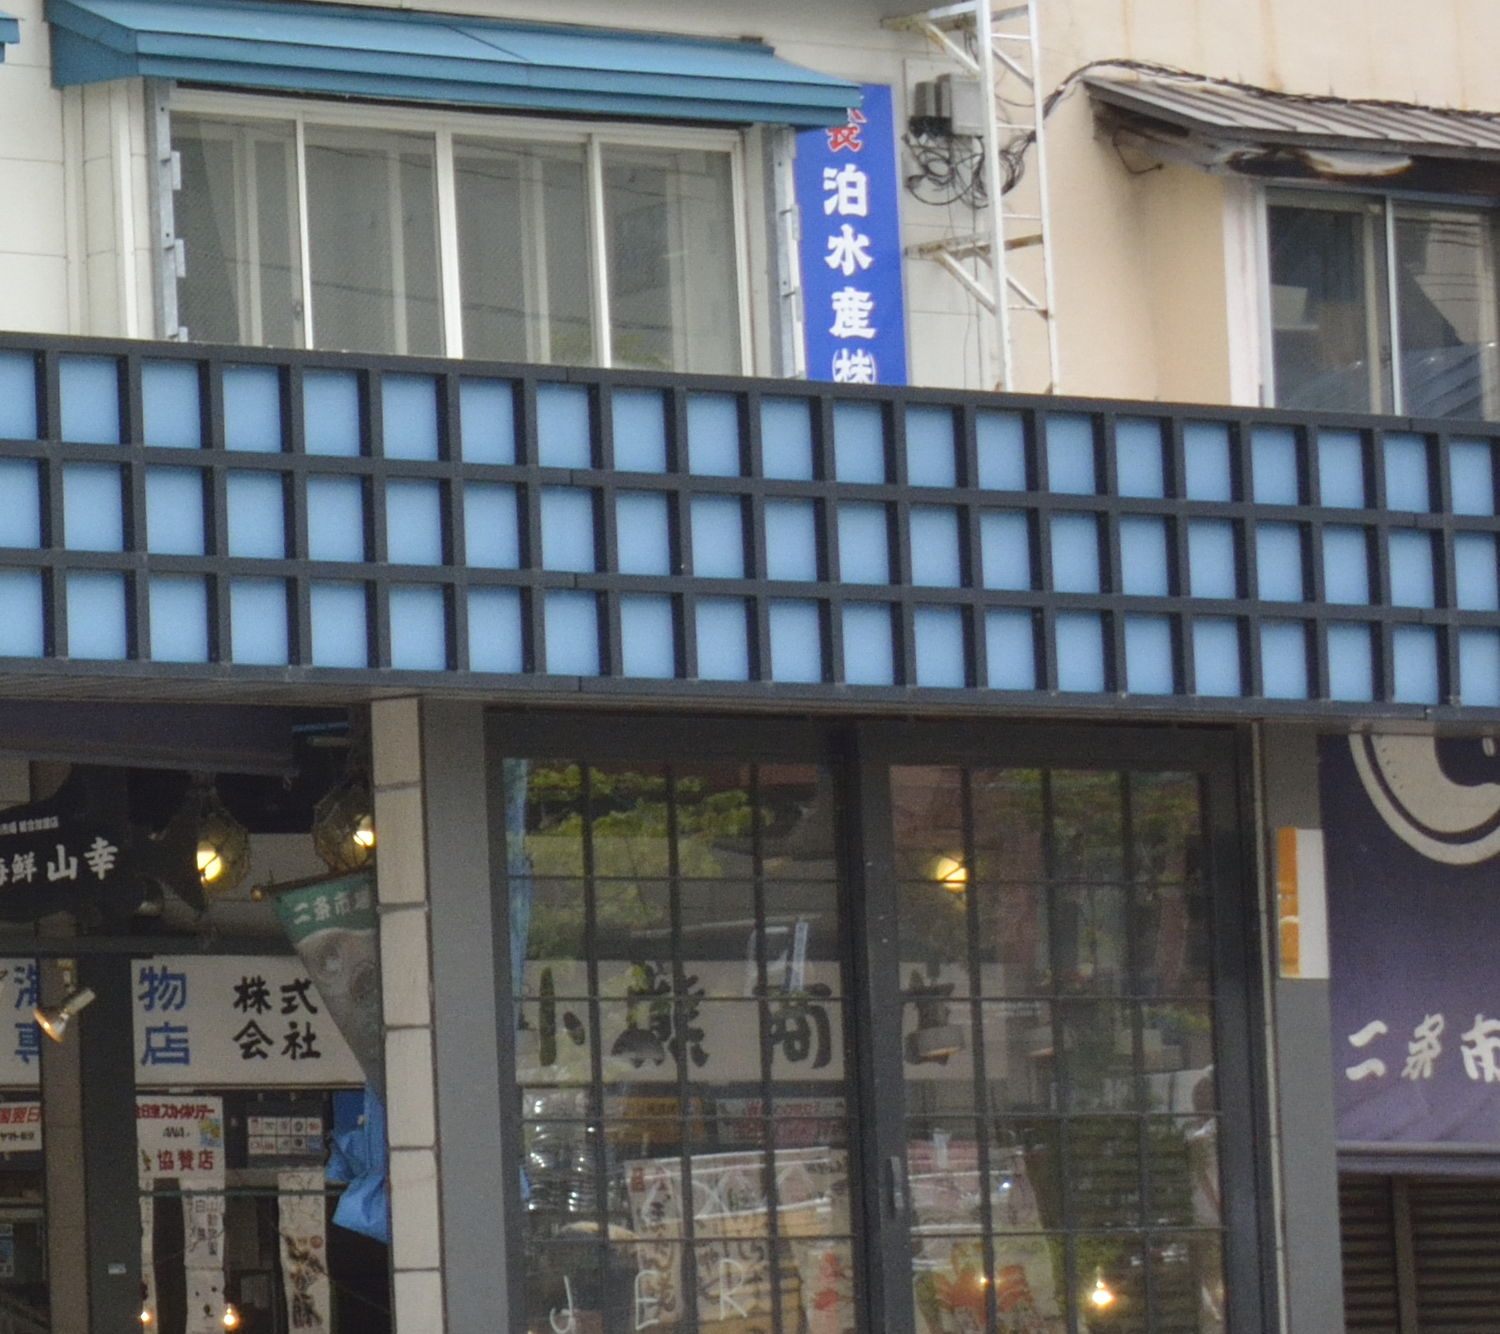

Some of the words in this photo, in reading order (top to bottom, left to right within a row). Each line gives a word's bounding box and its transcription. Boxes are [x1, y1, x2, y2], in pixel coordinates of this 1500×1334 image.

[46, 836, 119, 883] 山幸
[233, 975, 319, 1016] 株式
[233, 1020, 322, 1061] 会社
[157, 1149, 215, 1172] 協賛店
